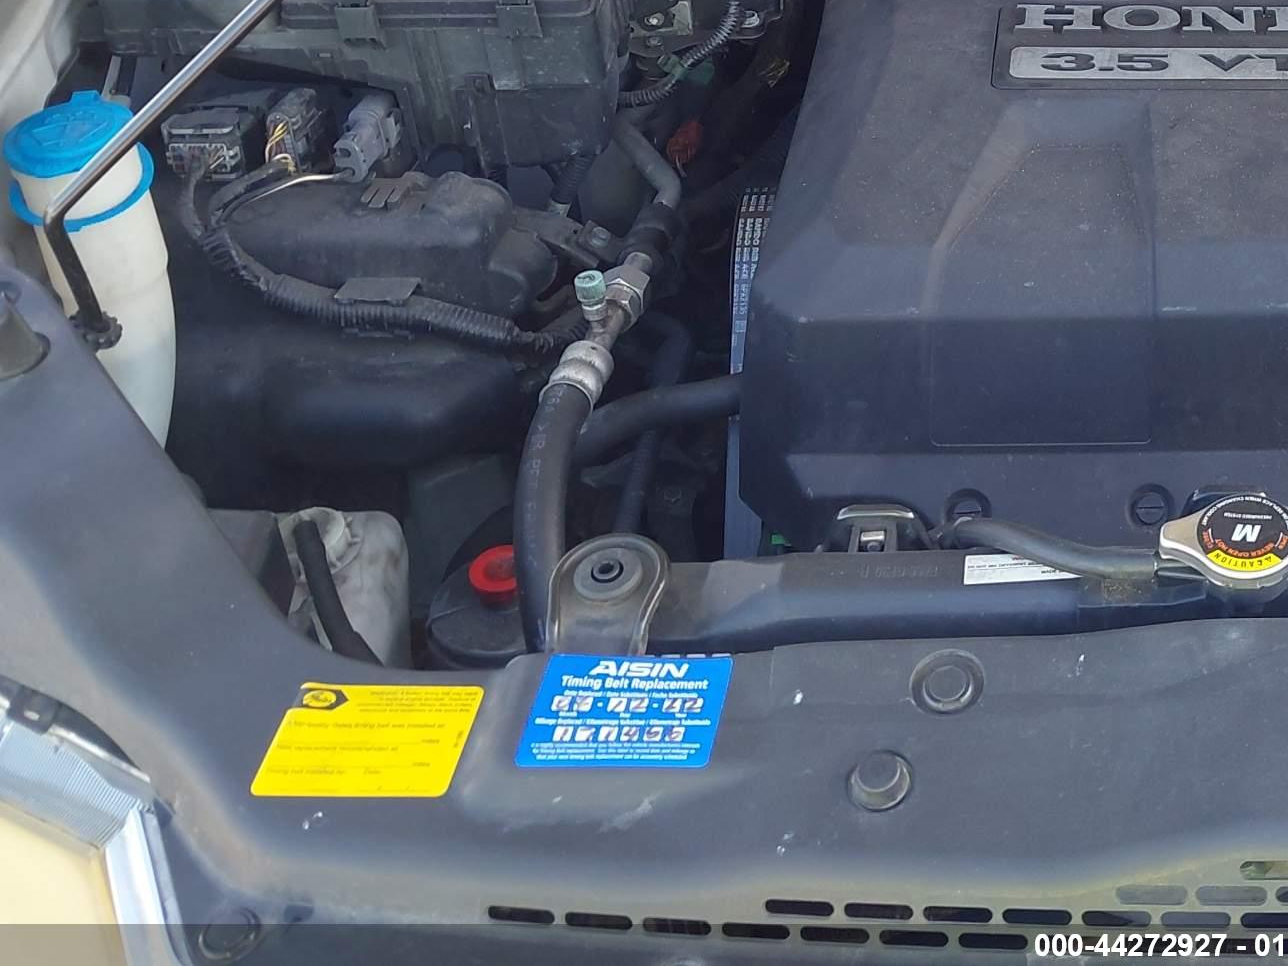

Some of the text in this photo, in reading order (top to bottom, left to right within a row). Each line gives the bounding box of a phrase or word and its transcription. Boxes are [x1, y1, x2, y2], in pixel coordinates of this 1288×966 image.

[1040, 52, 1169, 72] 3.5
[1262, 498, 1284, 515] REPLACE
[1214, 553, 1263, 567] CAUTION
[1229, 547, 1250, 557] OPEN
[590, 660, 690, 678] AISIN
[561, 675, 709, 692] Timing Belt Replacement
